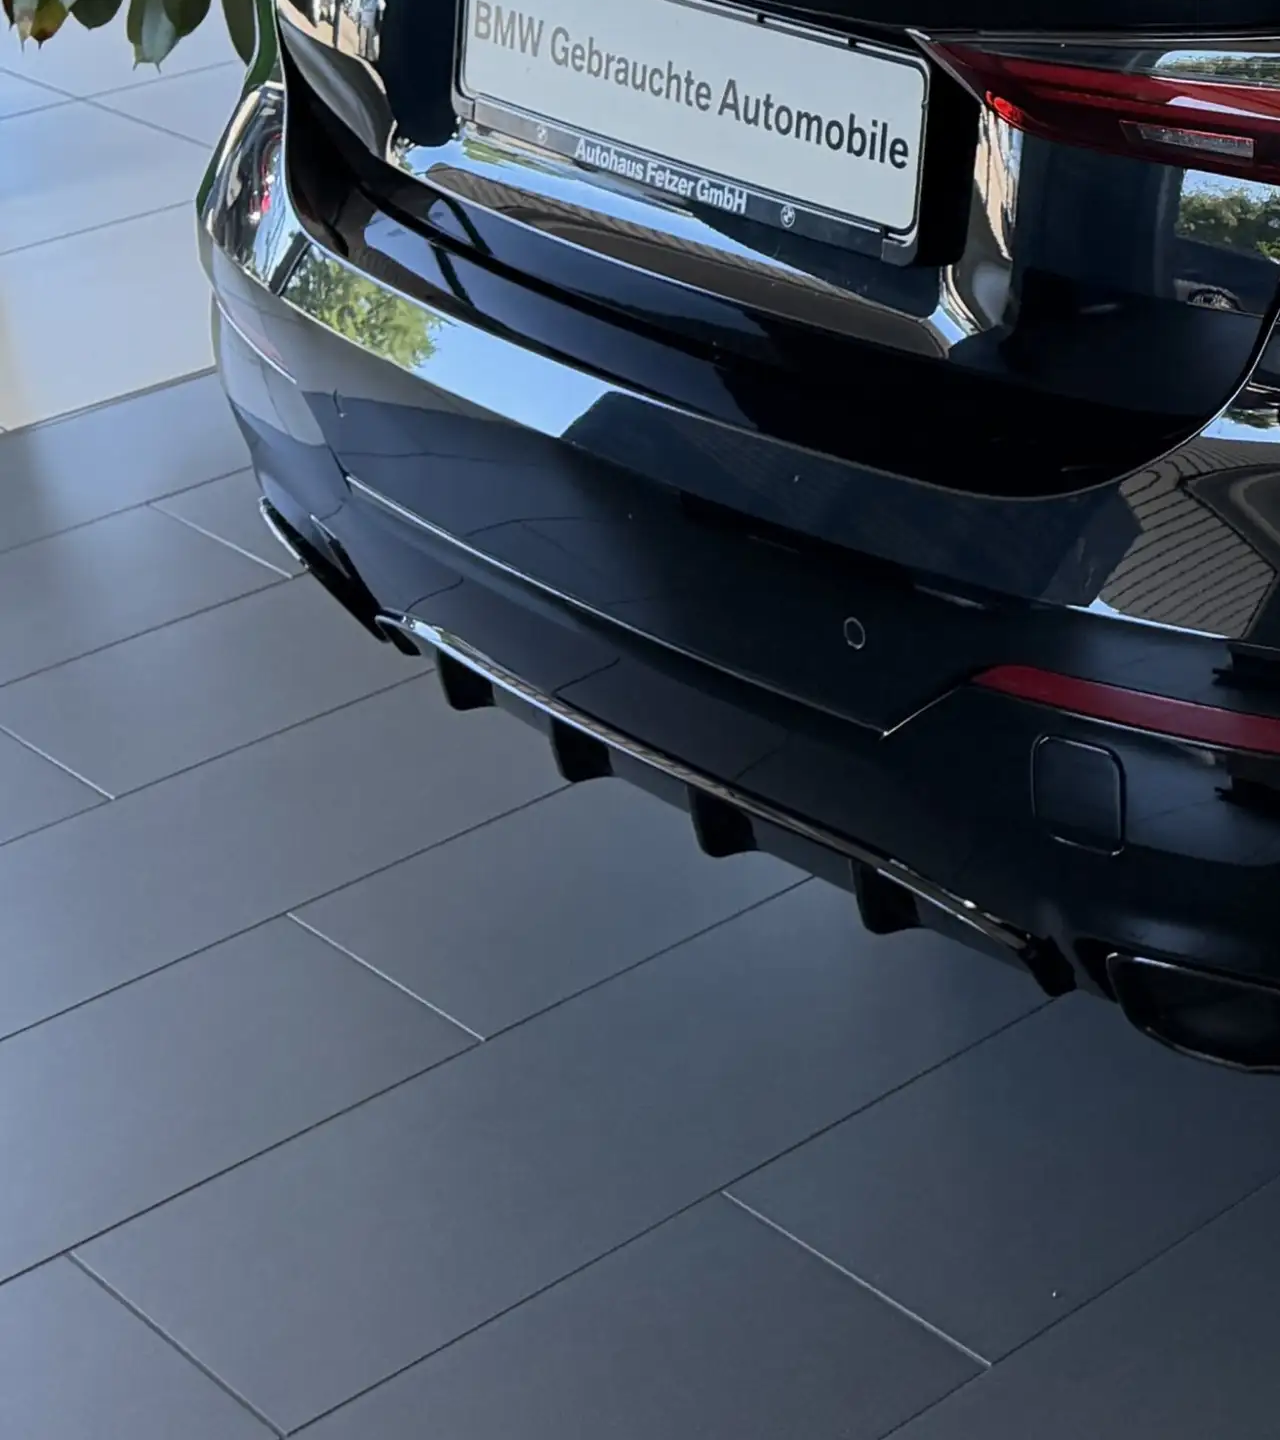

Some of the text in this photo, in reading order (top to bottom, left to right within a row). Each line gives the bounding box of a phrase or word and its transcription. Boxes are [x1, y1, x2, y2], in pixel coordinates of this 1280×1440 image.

[474, 0, 909, 169] BMW Gebrauchte Automobile
[574, 137, 748, 215] Autohaus Fetzer GmbH
